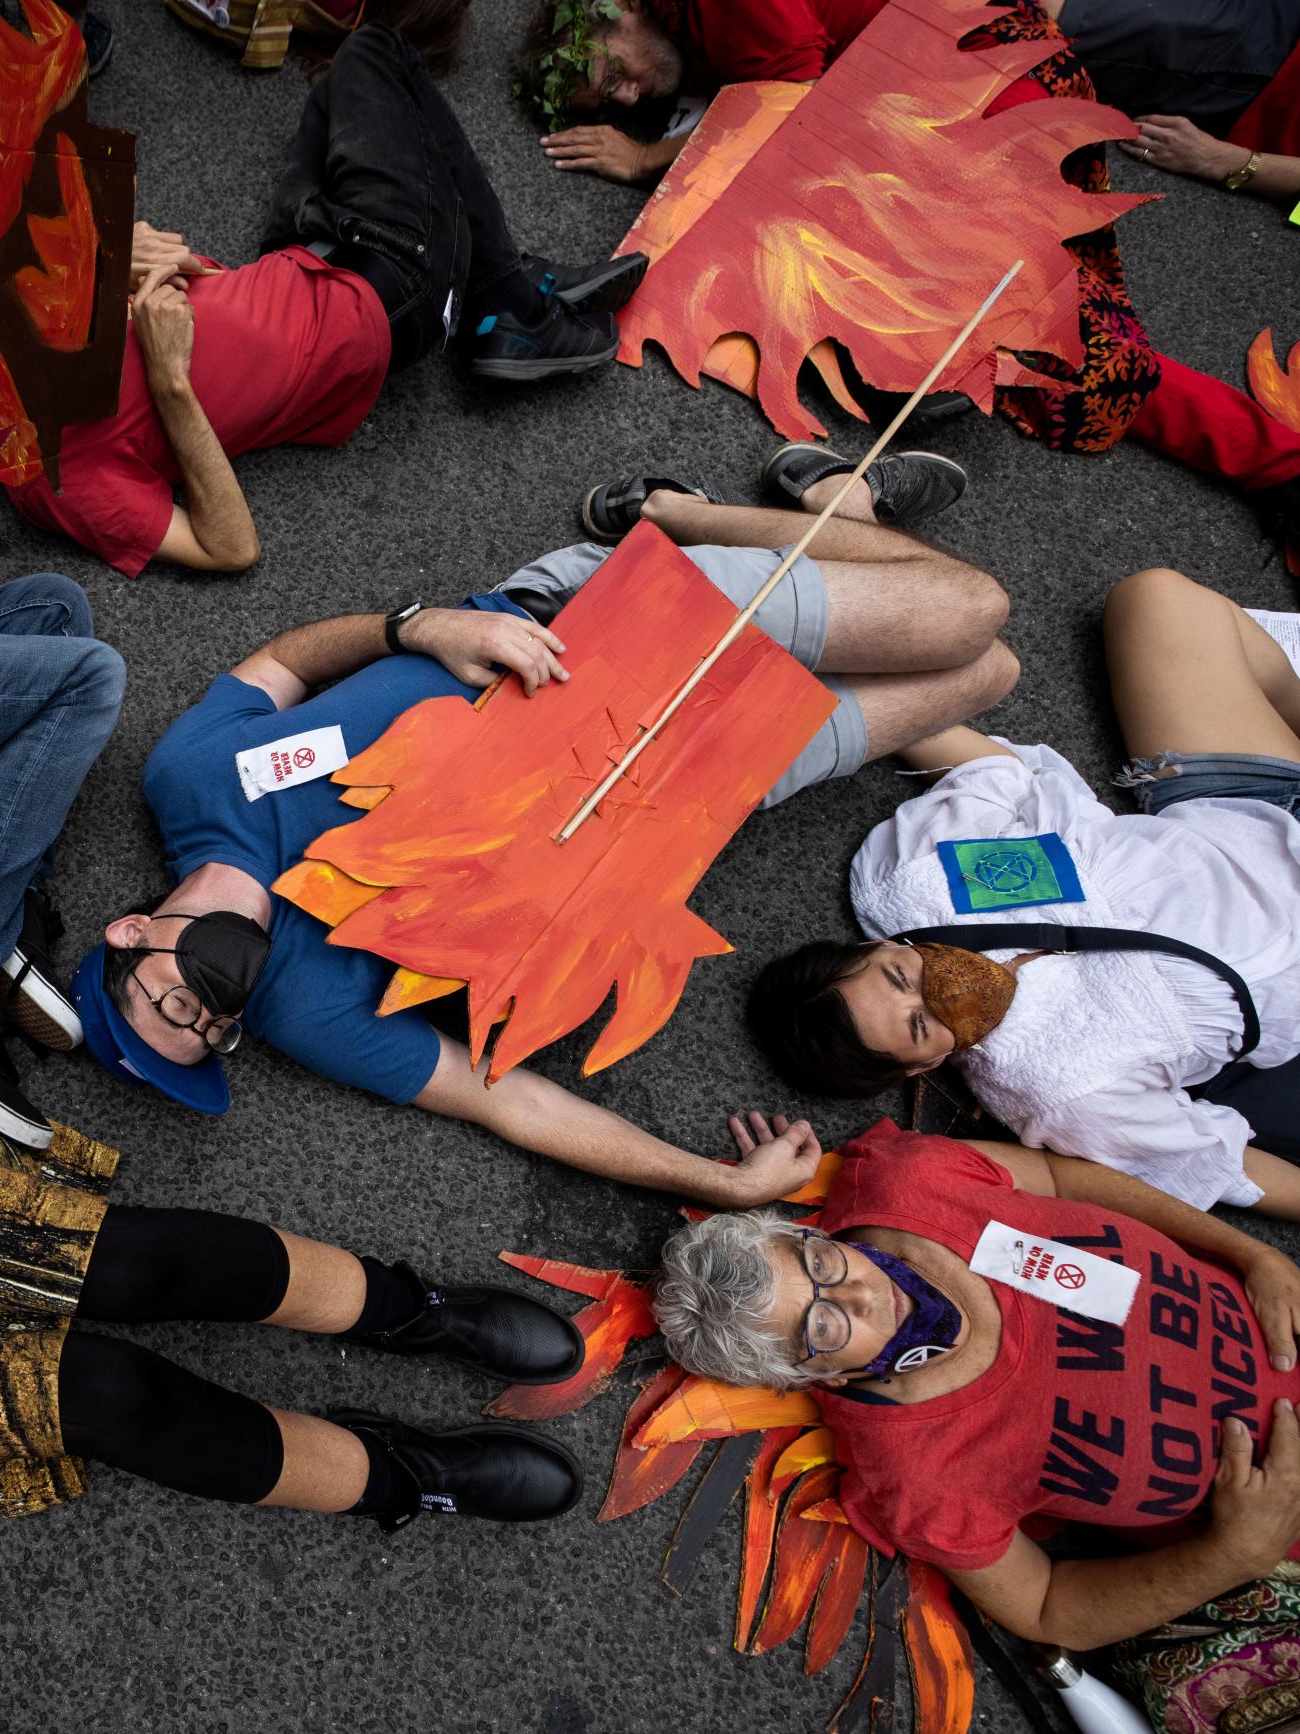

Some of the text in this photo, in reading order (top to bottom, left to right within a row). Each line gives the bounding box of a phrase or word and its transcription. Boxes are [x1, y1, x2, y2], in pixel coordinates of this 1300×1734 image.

[270, 751, 284, 781] NOW OR
[280, 752, 293, 776] NEVER
[1020, 1246, 1044, 1280] NOW OR
[1035, 1253, 1054, 1280] NEVER
[1038, 1224, 1125, 1506] WE WL
[1136, 1250, 1201, 1517] NOT BE
